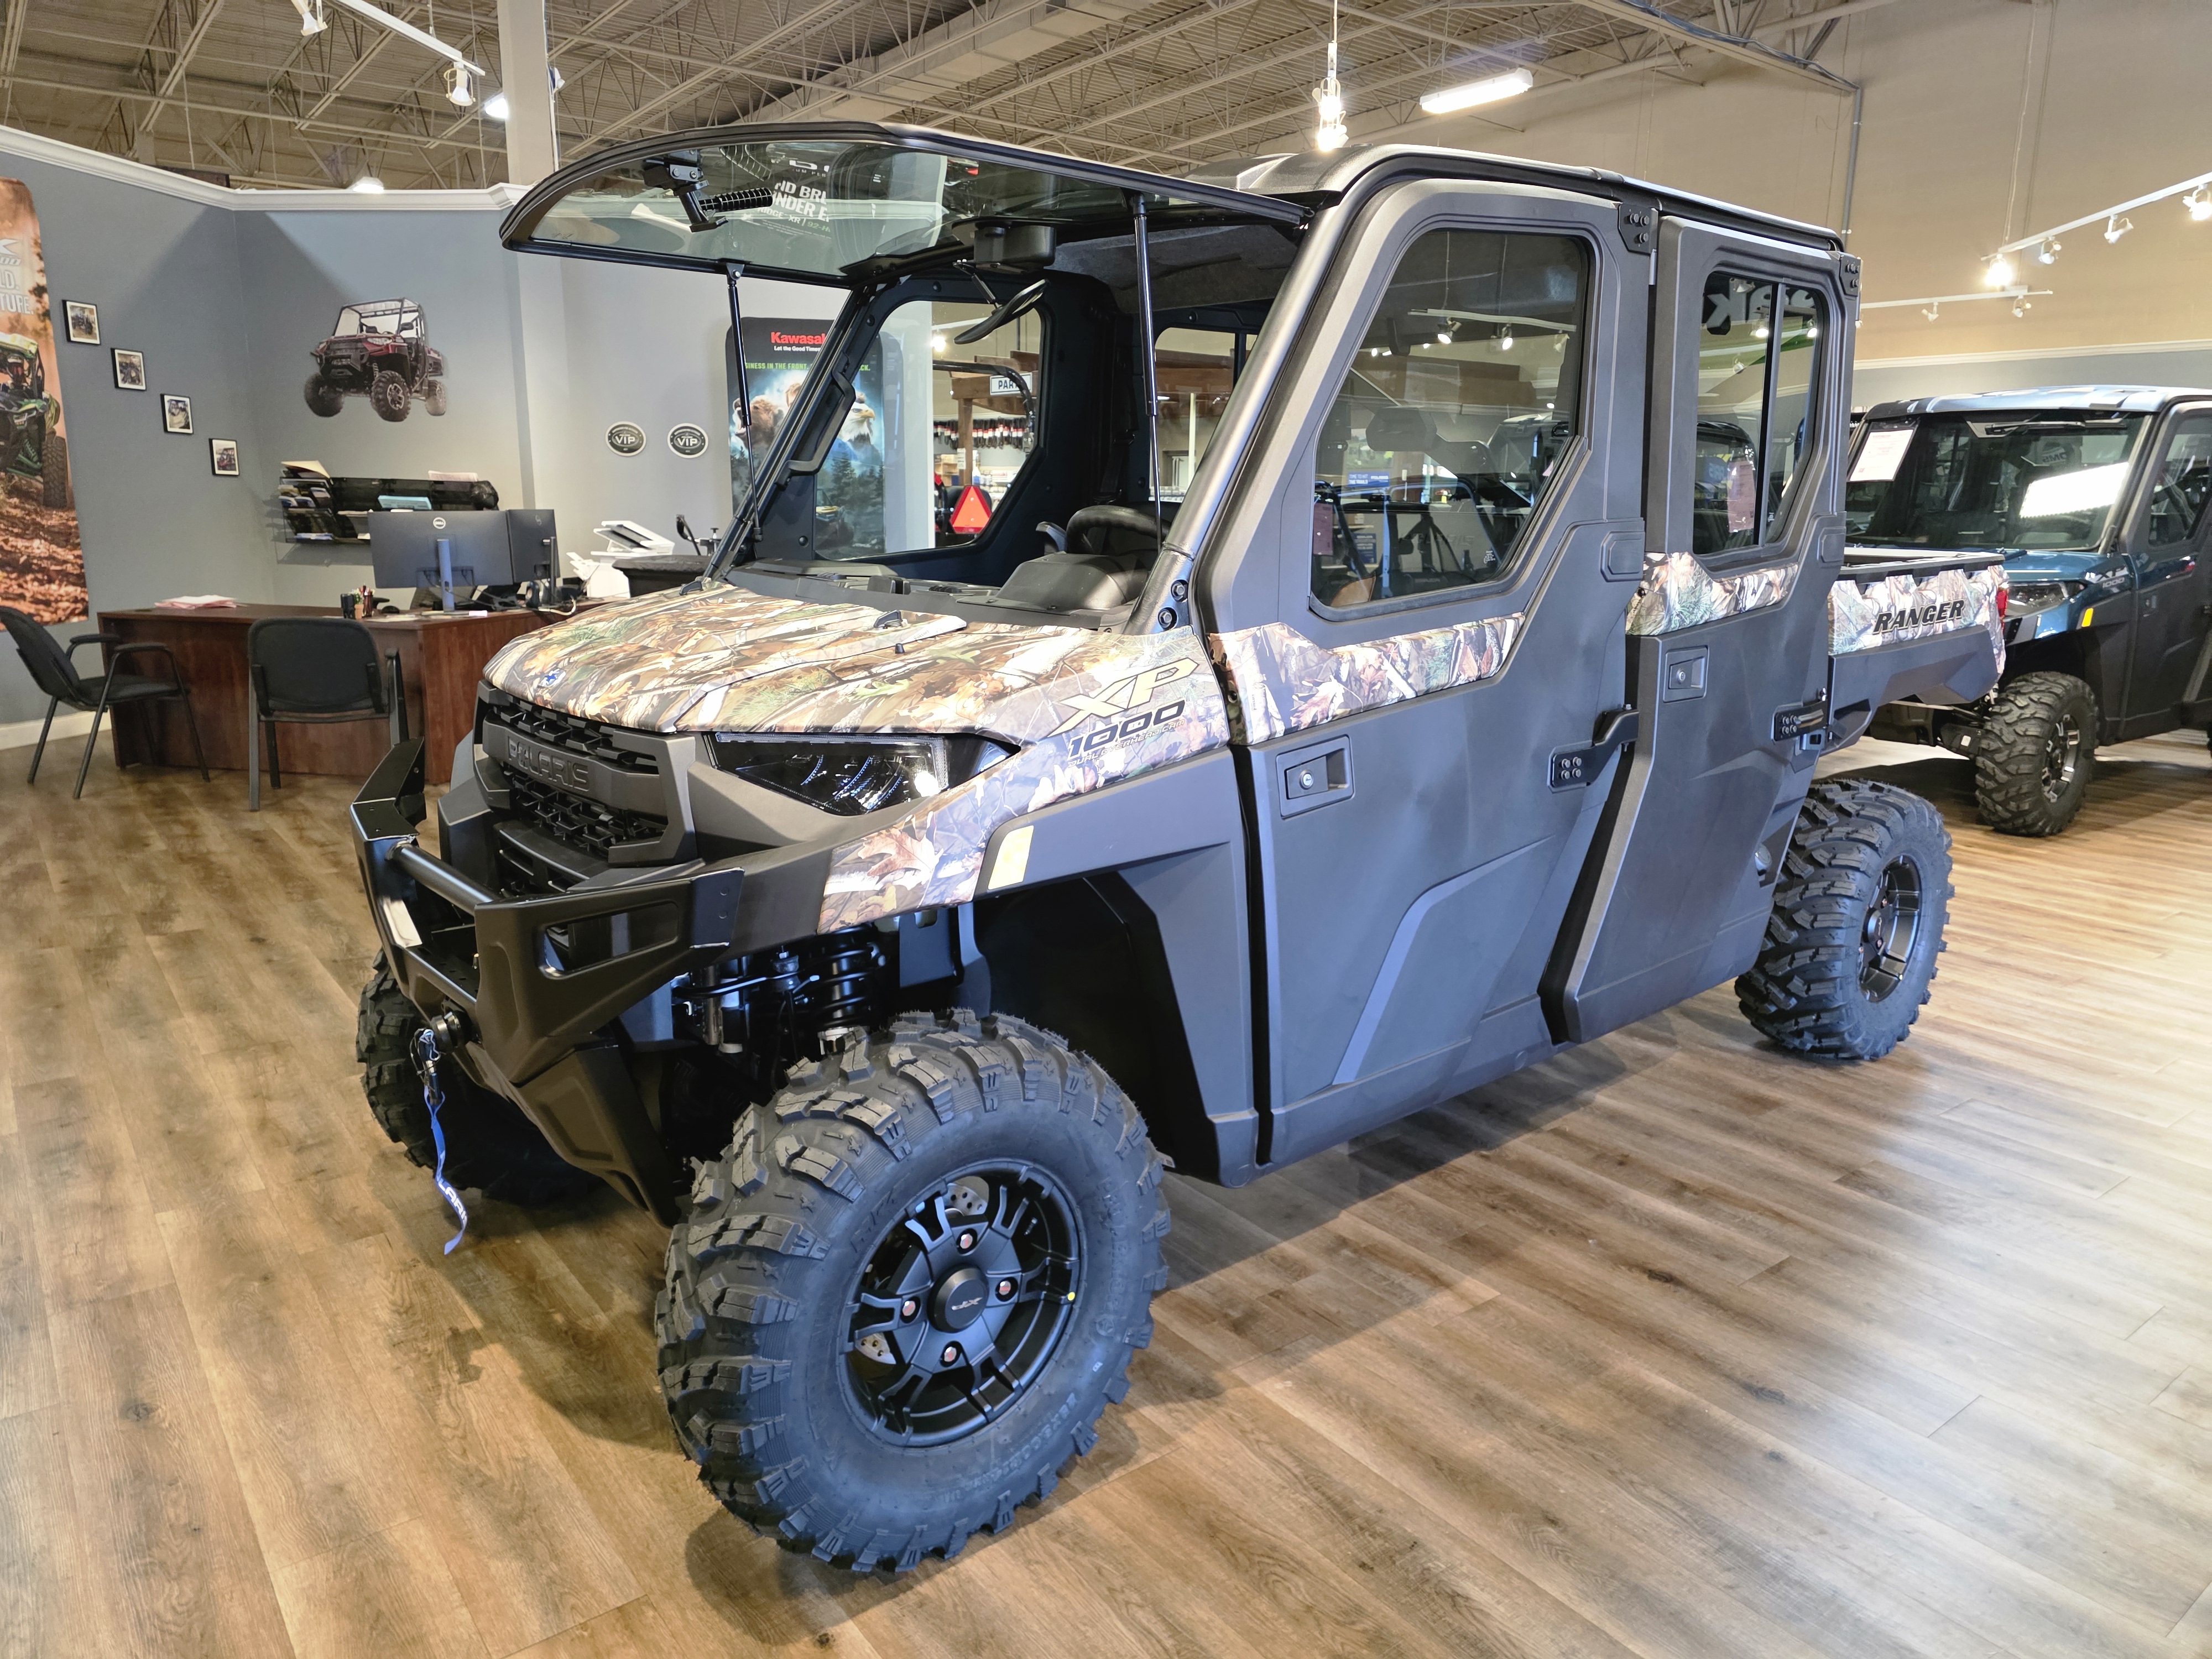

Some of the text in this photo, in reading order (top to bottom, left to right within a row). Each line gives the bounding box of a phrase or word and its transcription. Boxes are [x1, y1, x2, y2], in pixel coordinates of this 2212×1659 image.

[615, 436, 635, 444] VIP
[677, 437, 698, 446] VIP
[2103, 577, 2125, 588] 1000
[1872, 599, 1965, 635] RANGER
[1046, 657, 1200, 738] XP
[1067, 699, 1186, 760] 1000
[1068, 719, 1186, 768] DUAL OVERHEAD CAM
[507, 734, 590, 792] POLARIS
